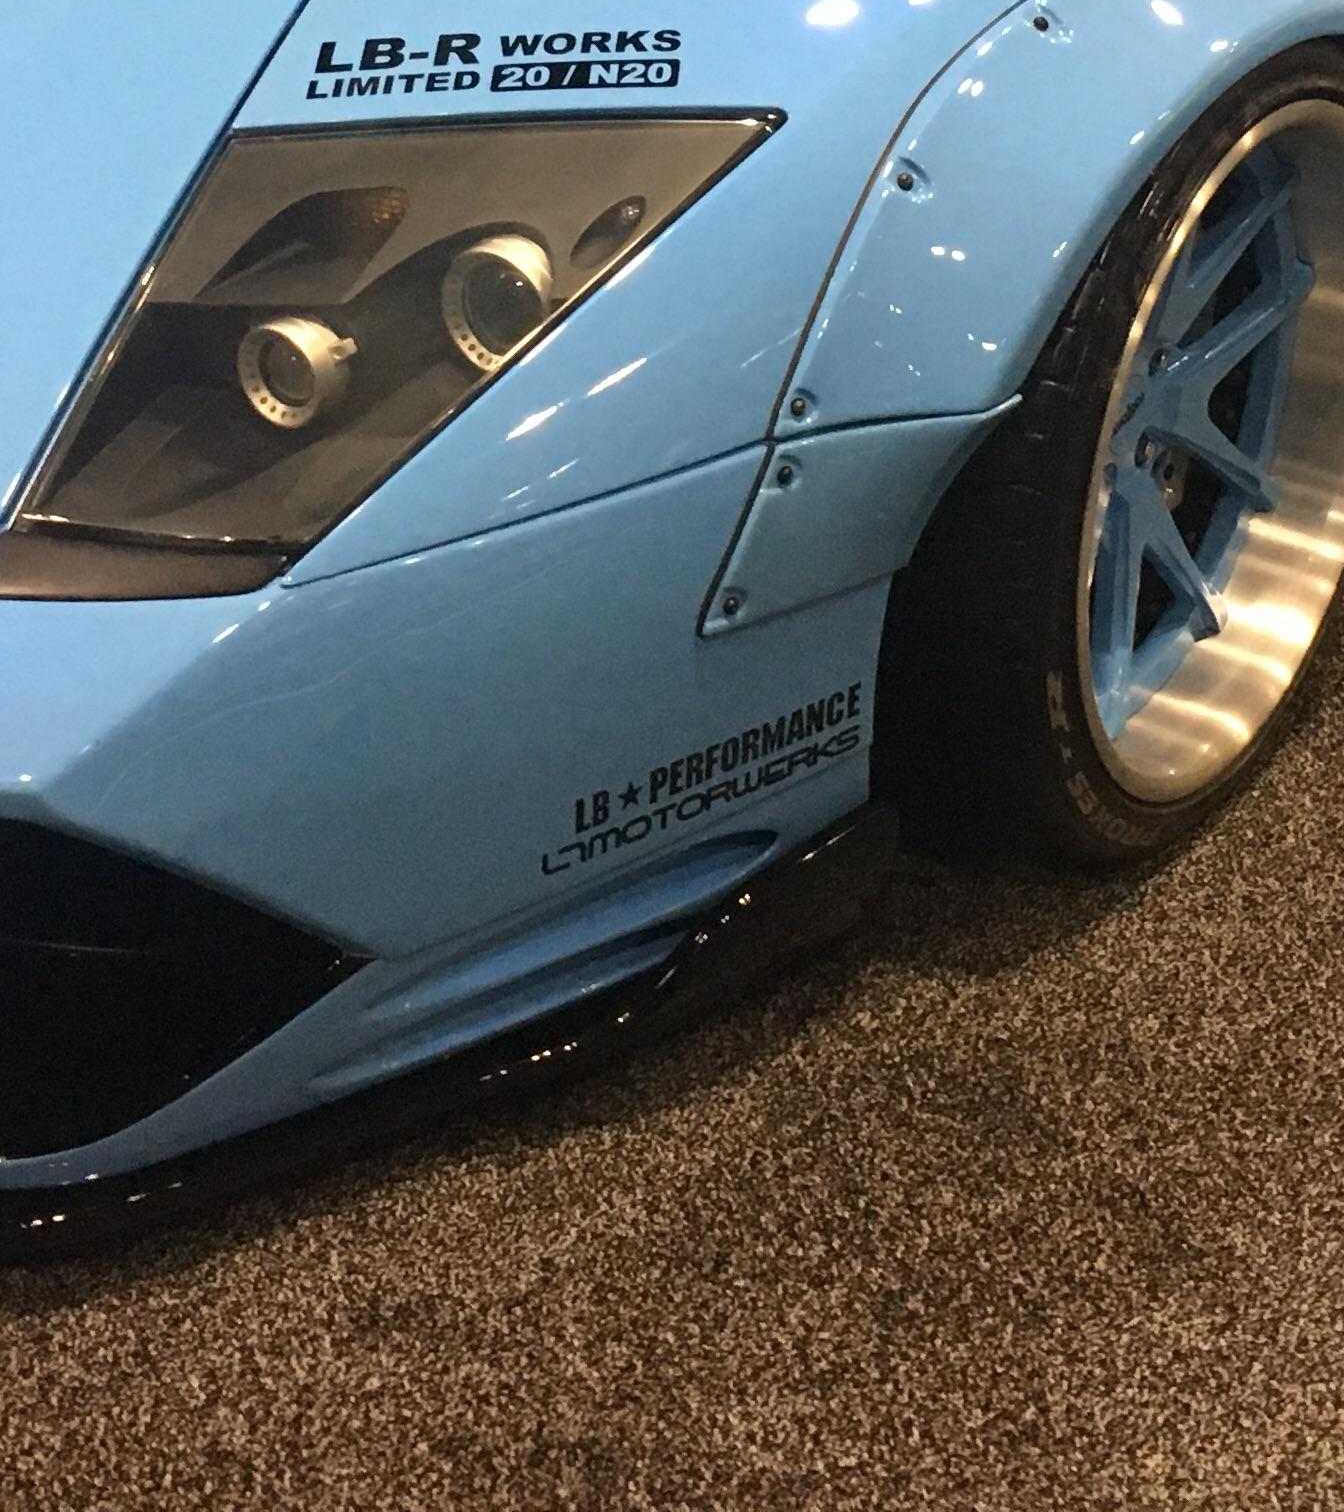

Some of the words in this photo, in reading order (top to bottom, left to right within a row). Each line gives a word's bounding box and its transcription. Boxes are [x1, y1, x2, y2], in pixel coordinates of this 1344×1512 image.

[314, 32, 482, 73] LB-R
[500, 29, 682, 57] WORKS
[306, 71, 480, 99] LIMITED
[497, 64, 547, 88] 20
[587, 60, 674, 85] N20
[574, 789, 610, 835] LB
[649, 681, 863, 805] PERFORMANCE
